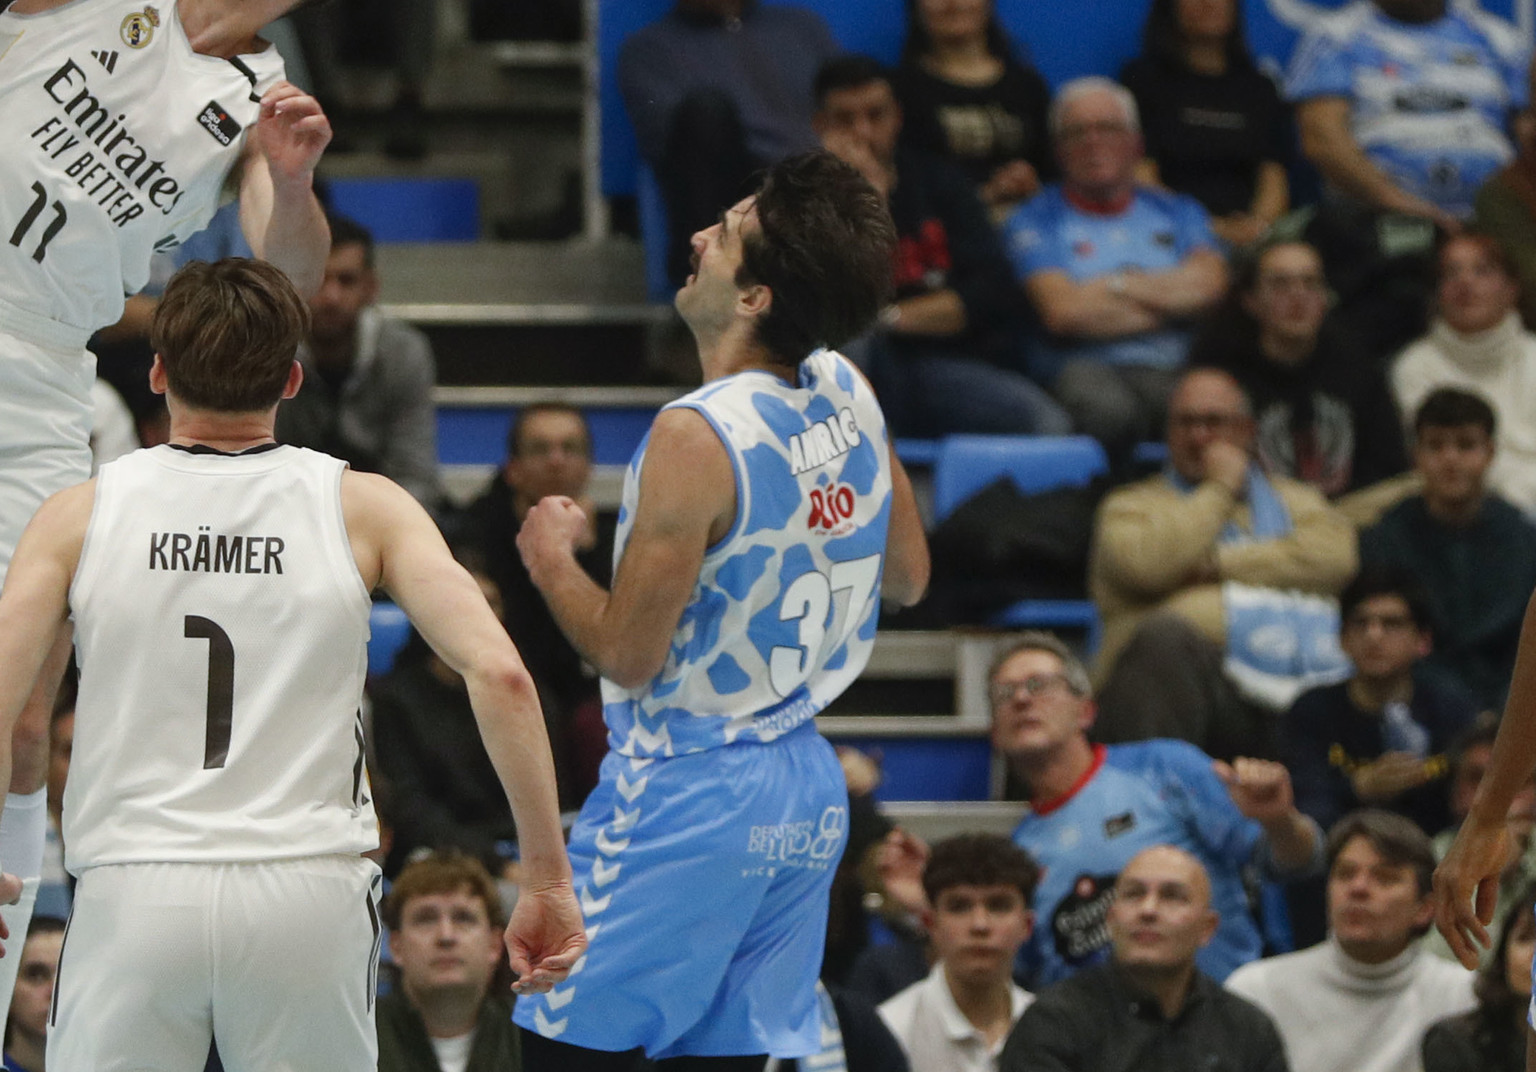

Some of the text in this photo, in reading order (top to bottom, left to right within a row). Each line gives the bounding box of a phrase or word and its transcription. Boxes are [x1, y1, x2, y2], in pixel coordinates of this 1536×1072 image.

[31, 118, 145, 228] FLY BETTER
[42, 58, 186, 216] Emirates
[9, 181, 68, 264] 11
[148, 525, 285, 575] KRÄMER
[769, 553, 881, 700] 37
[184, 615, 234, 769] 1
